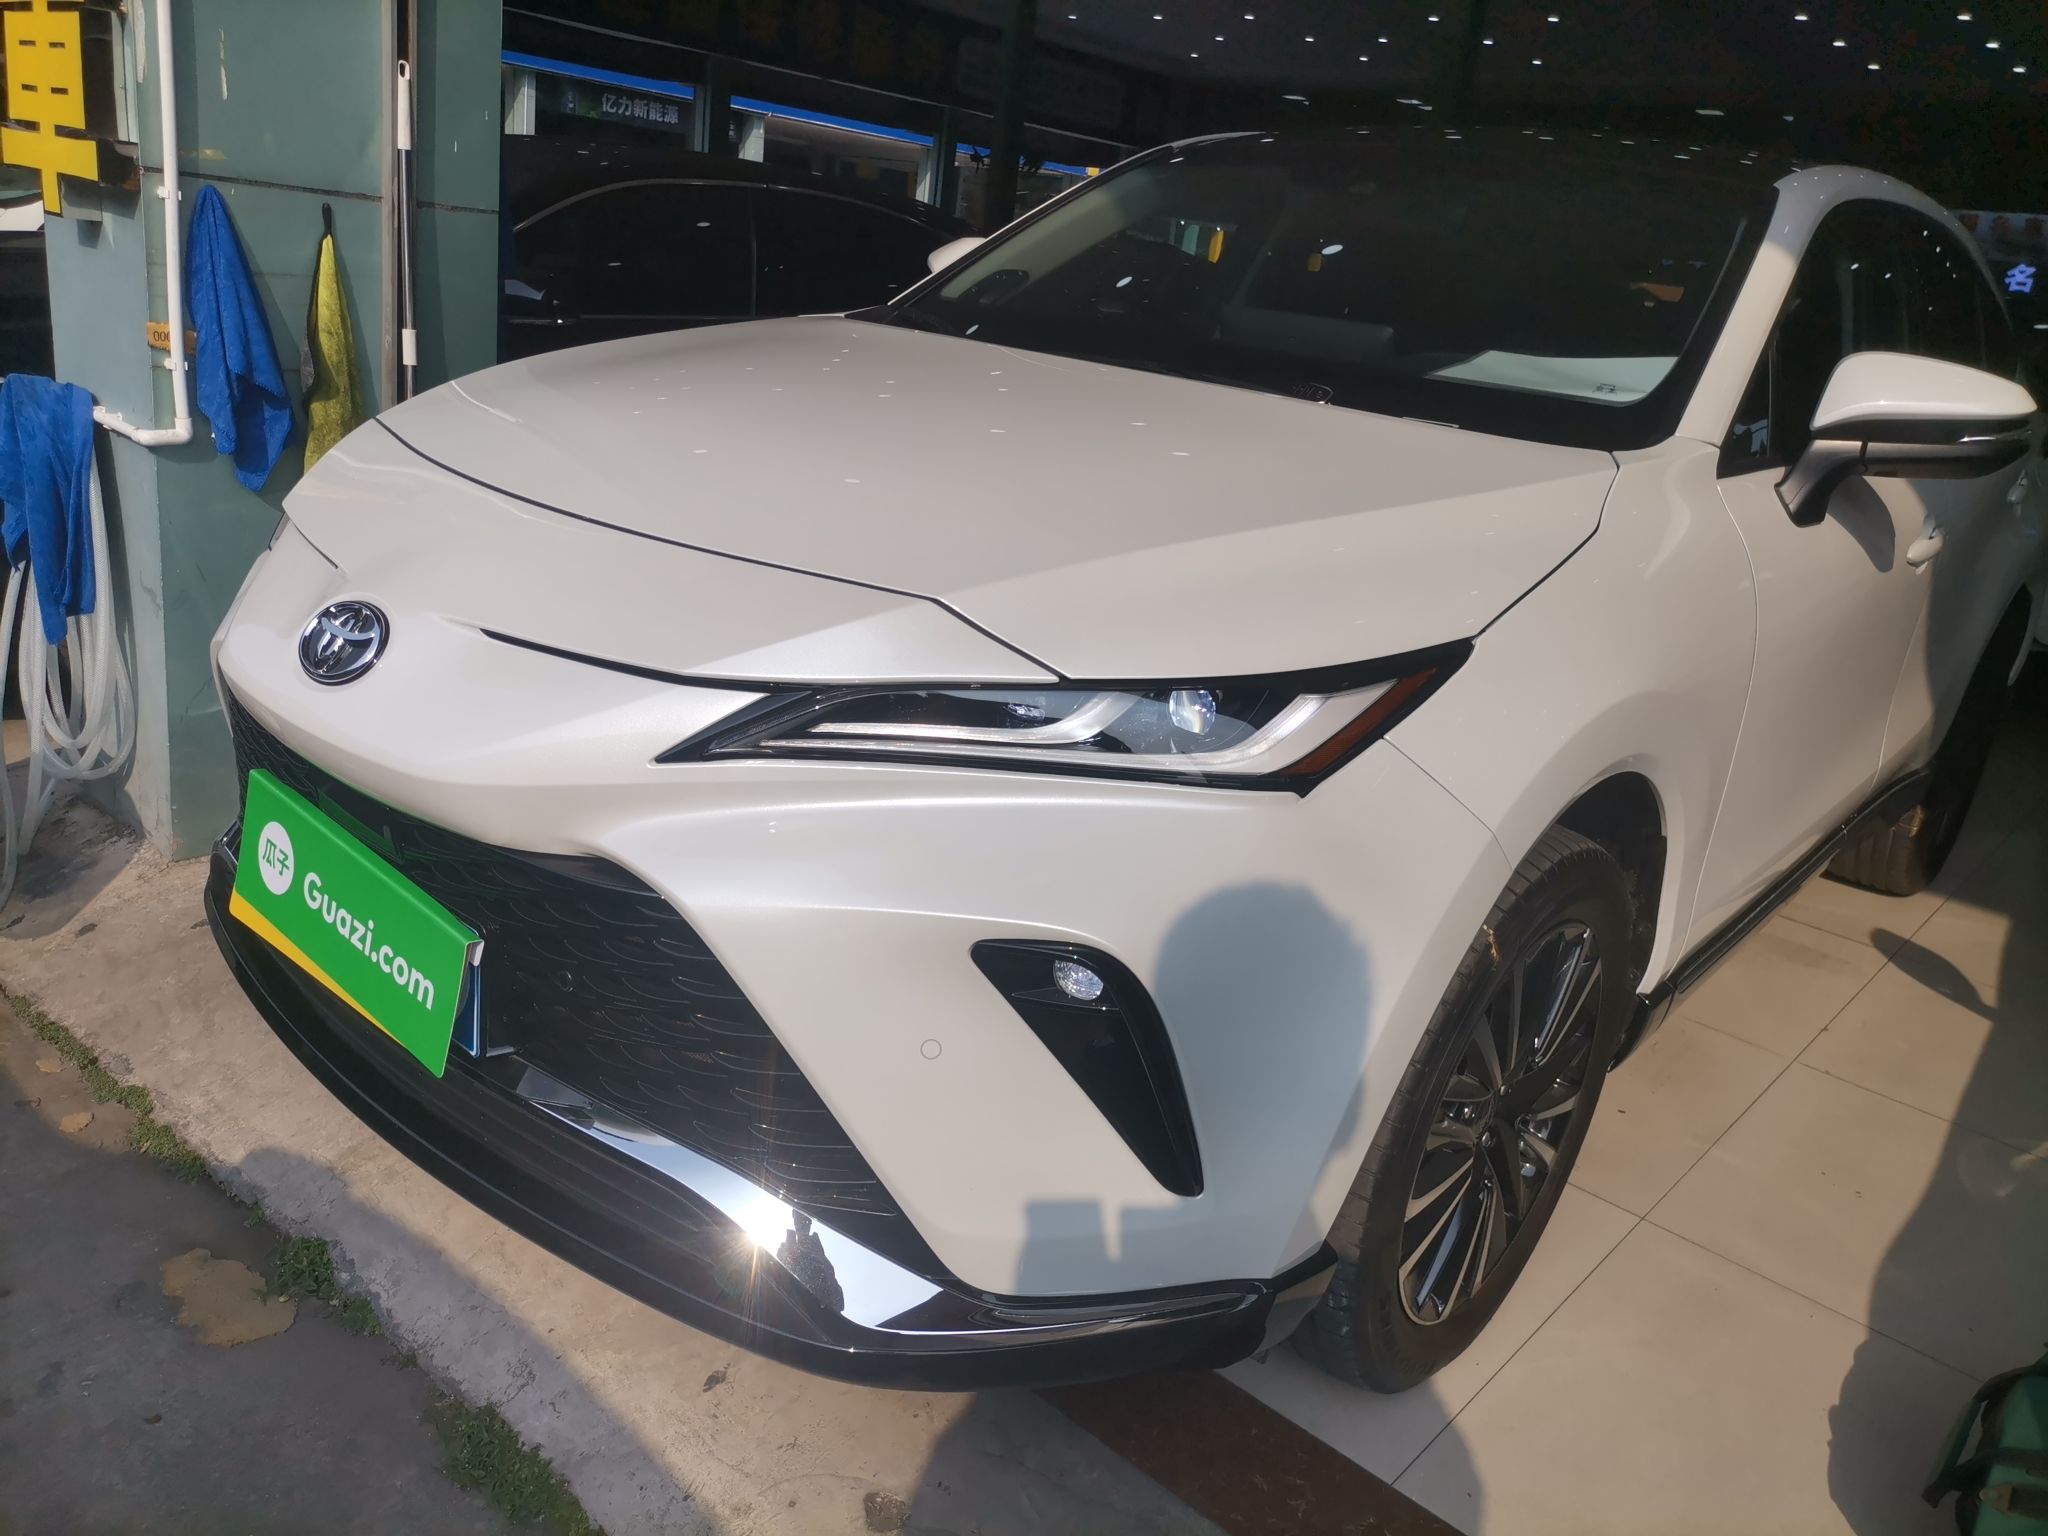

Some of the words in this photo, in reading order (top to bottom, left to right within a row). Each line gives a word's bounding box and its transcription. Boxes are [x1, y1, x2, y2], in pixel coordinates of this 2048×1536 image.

[602, 93, 679, 124] 亿力新能源
[2004, 264, 2037, 293] 名
[262, 838, 290, 876] 瓜子
[303, 871, 435, 1011] Guazi.com
